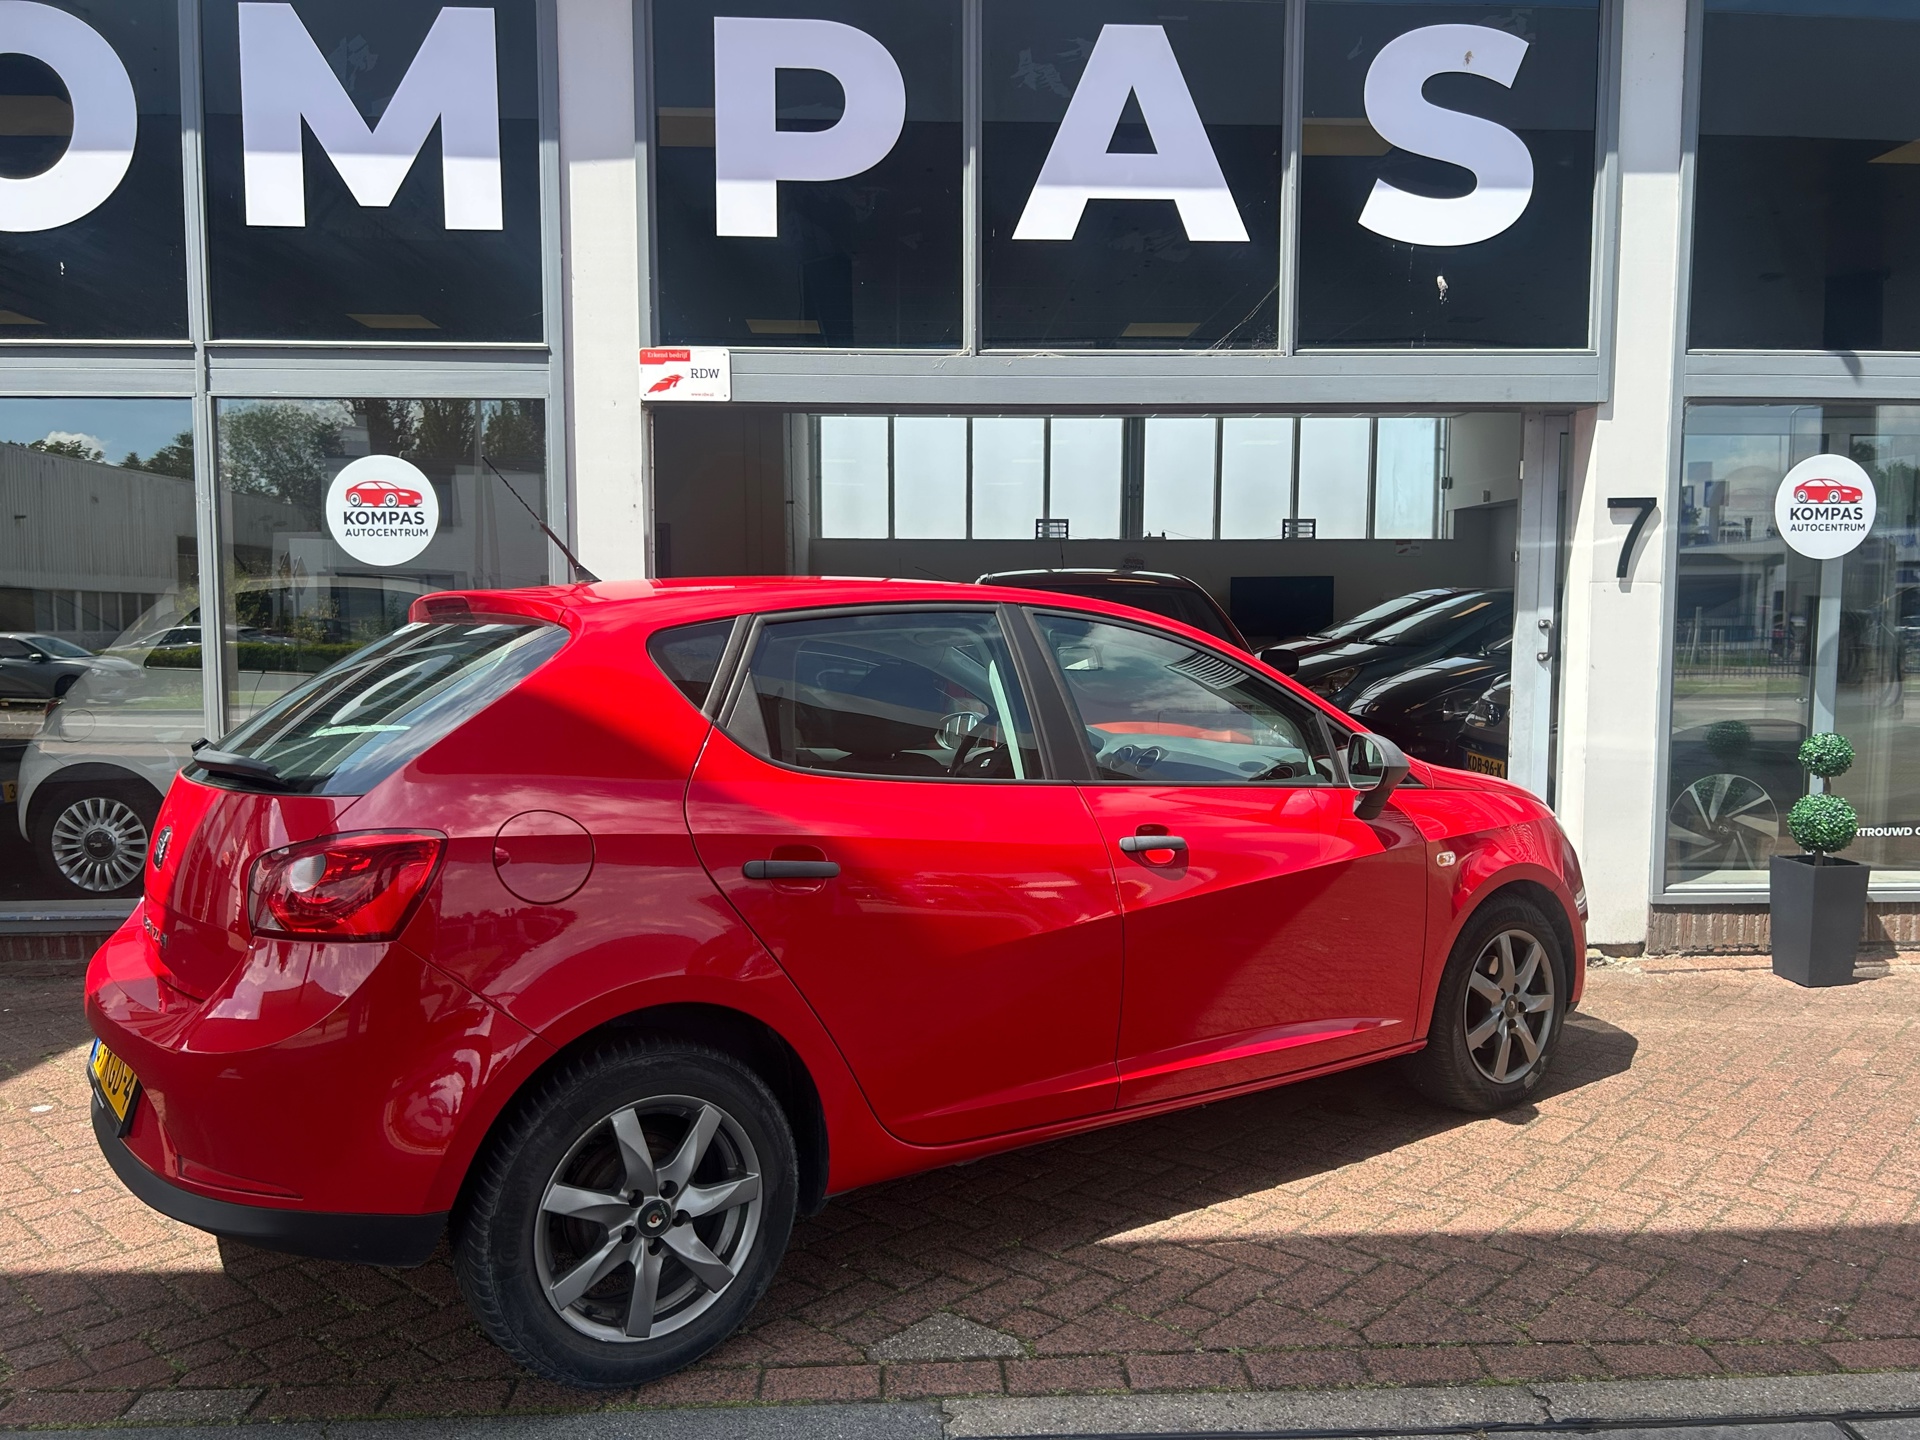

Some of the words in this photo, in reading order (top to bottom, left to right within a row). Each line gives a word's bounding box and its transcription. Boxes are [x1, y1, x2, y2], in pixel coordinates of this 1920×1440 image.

[669, 351, 688, 359] bedrijf
[690, 368, 720, 379] RDW
[343, 511, 425, 525] KOMPAS
[1790, 507, 1863, 521] KOMPAS
[345, 528, 429, 537] AUTOCENTRUM
[1790, 523, 1866, 532] AUTOCENTRUM
[1607, 497, 1657, 578] 7
[1467, 754, 1502, 778] KDB-96-K
